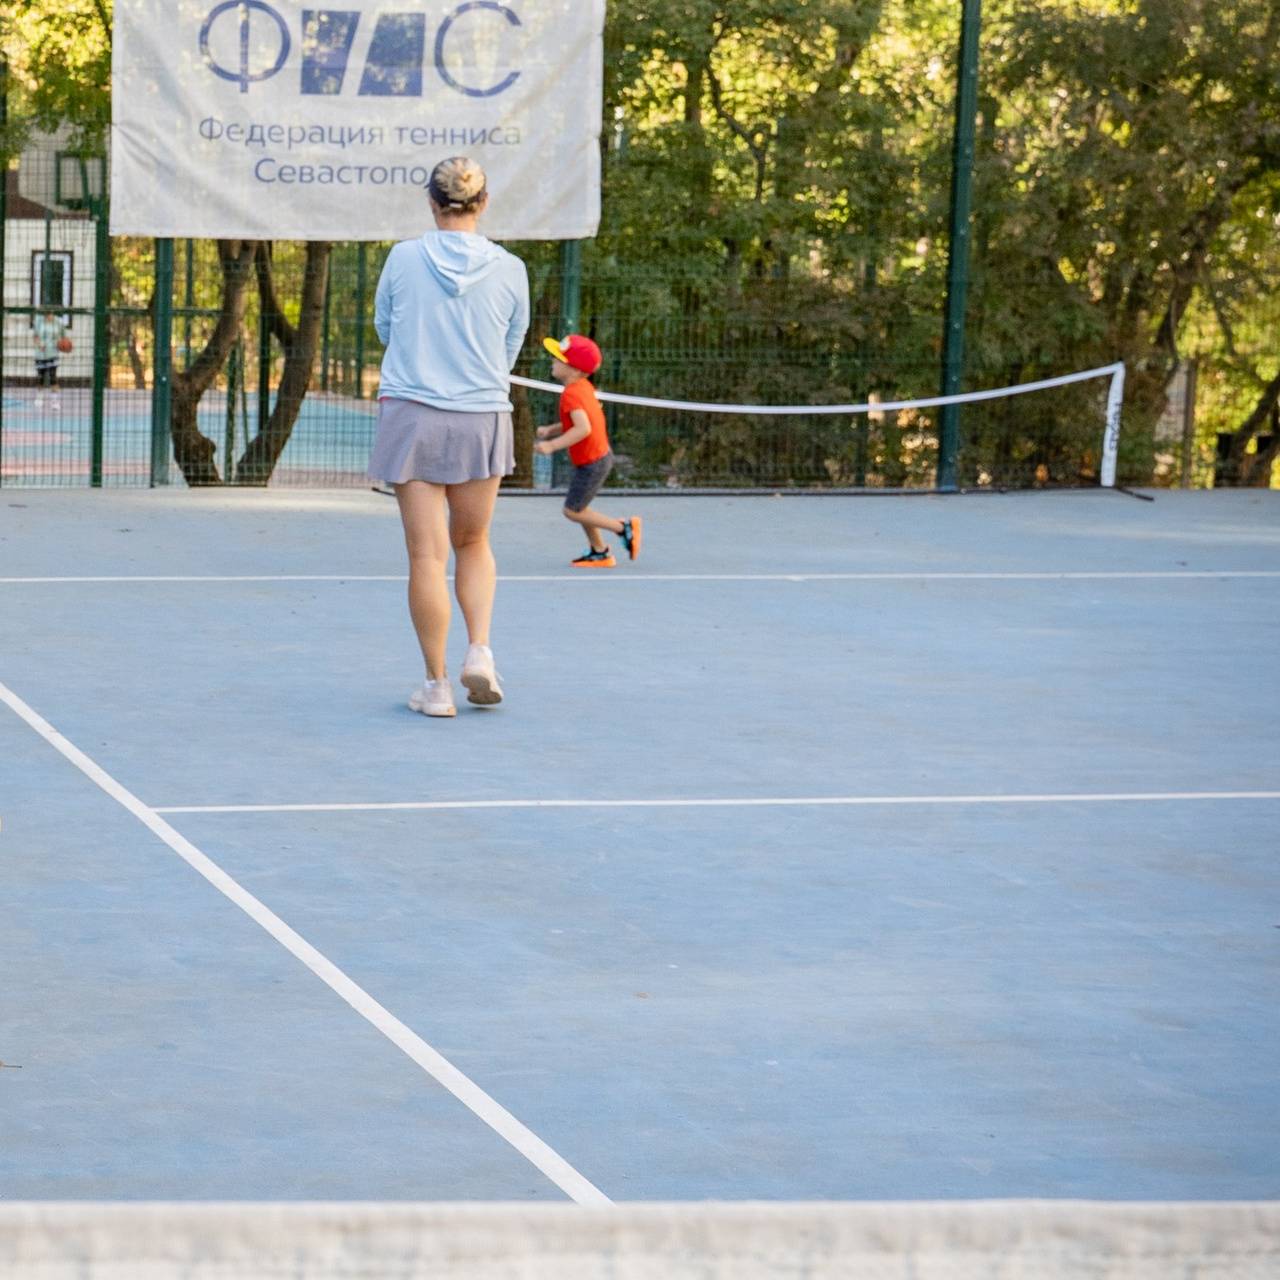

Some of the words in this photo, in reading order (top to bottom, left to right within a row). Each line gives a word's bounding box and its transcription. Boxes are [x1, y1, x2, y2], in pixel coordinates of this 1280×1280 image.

[198, 117, 385, 150] Федерация
[394, 125, 521, 146] тенниса
[254, 157, 433, 185] Севастопо
